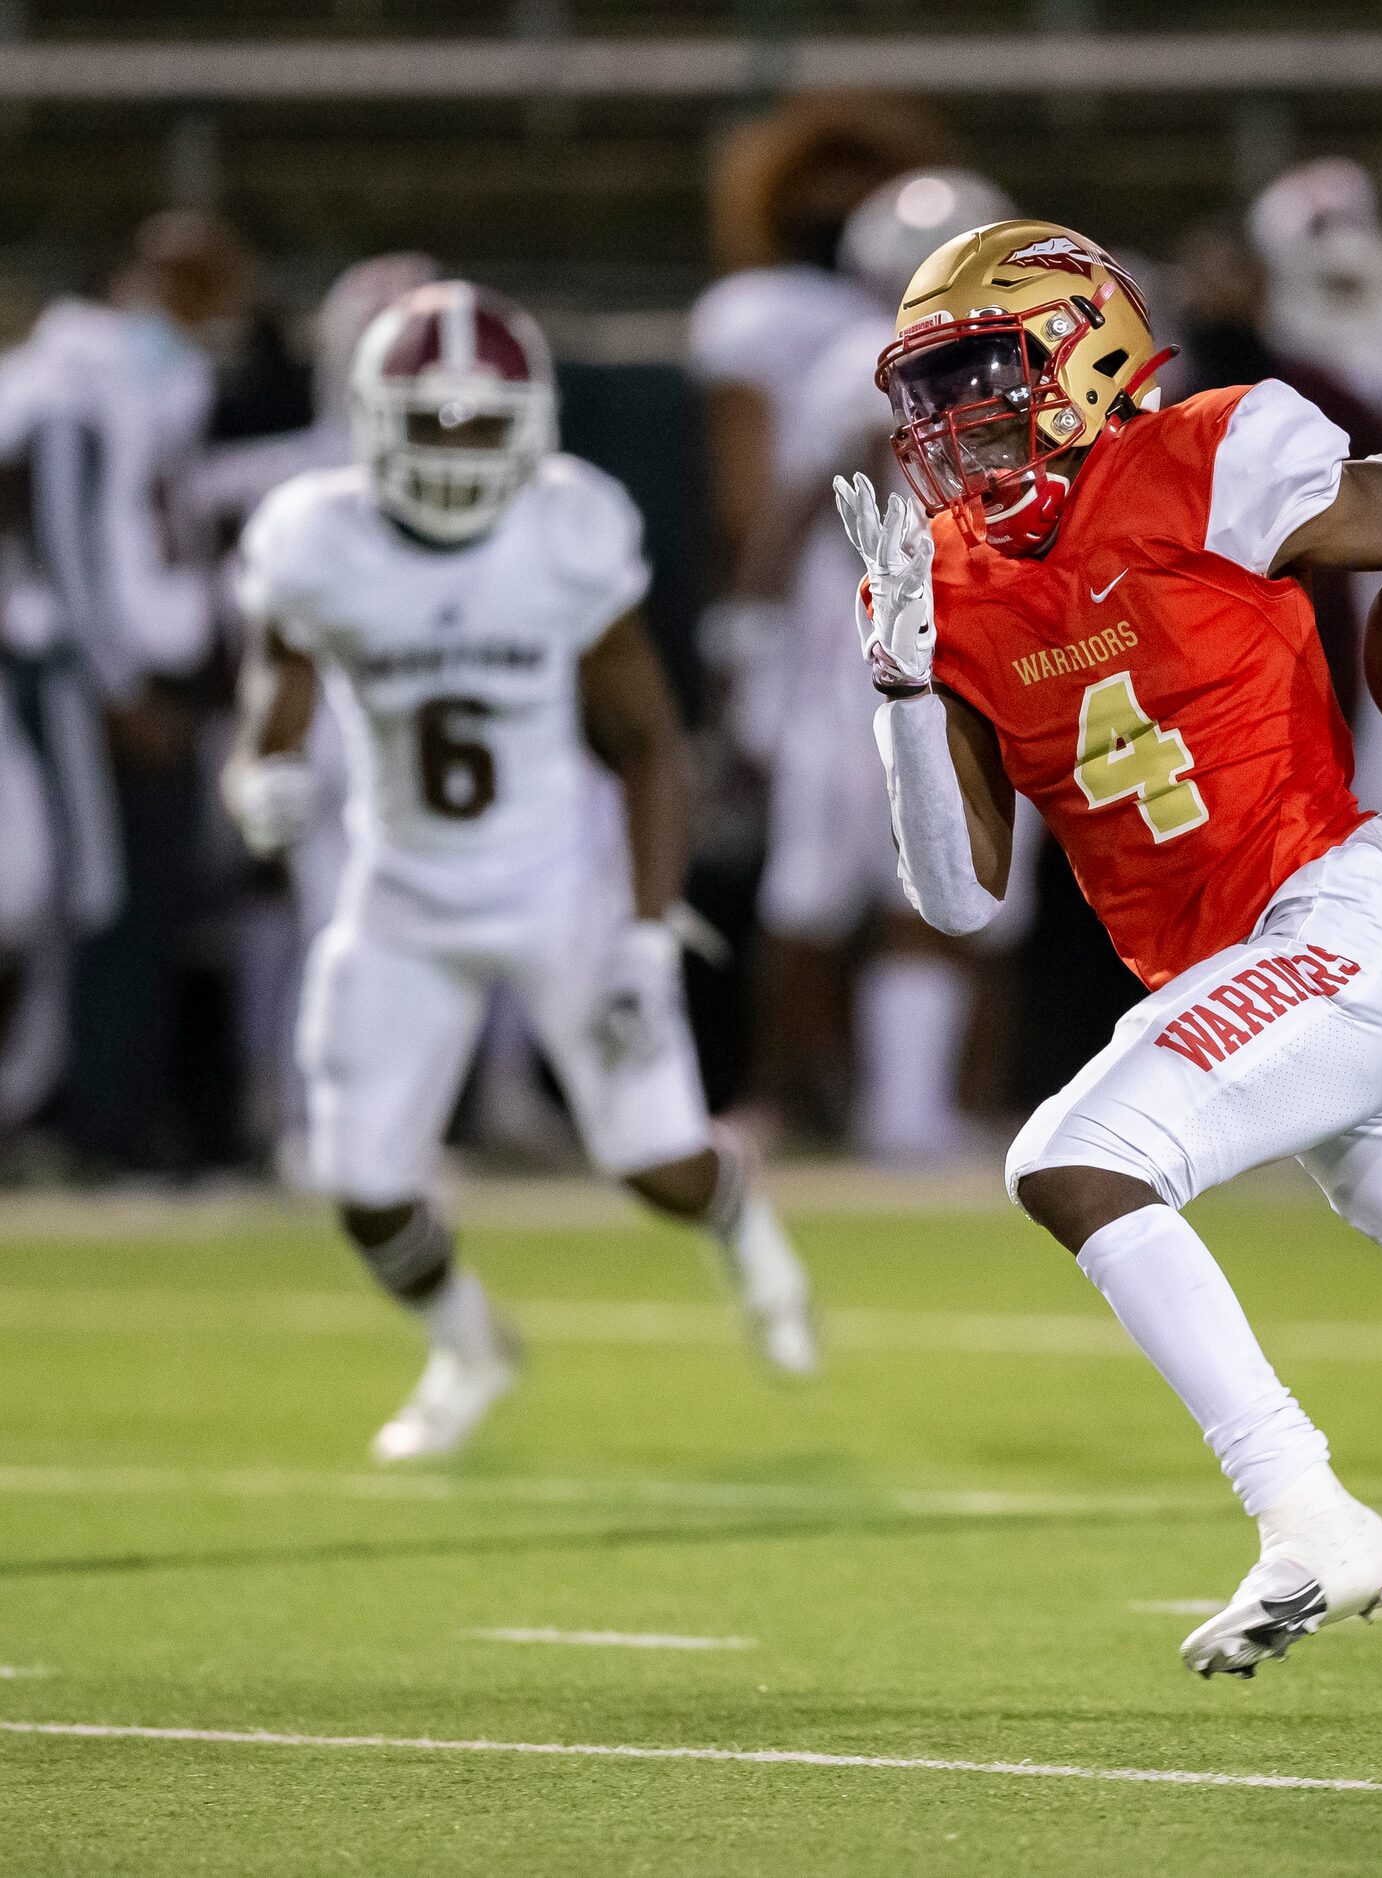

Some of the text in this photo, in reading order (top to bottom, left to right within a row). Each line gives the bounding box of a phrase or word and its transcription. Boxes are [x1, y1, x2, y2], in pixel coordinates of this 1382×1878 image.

[1012, 620, 1138, 686] WARRIORS
[415, 695, 498, 822] 6
[1074, 670, 1210, 845] 4
